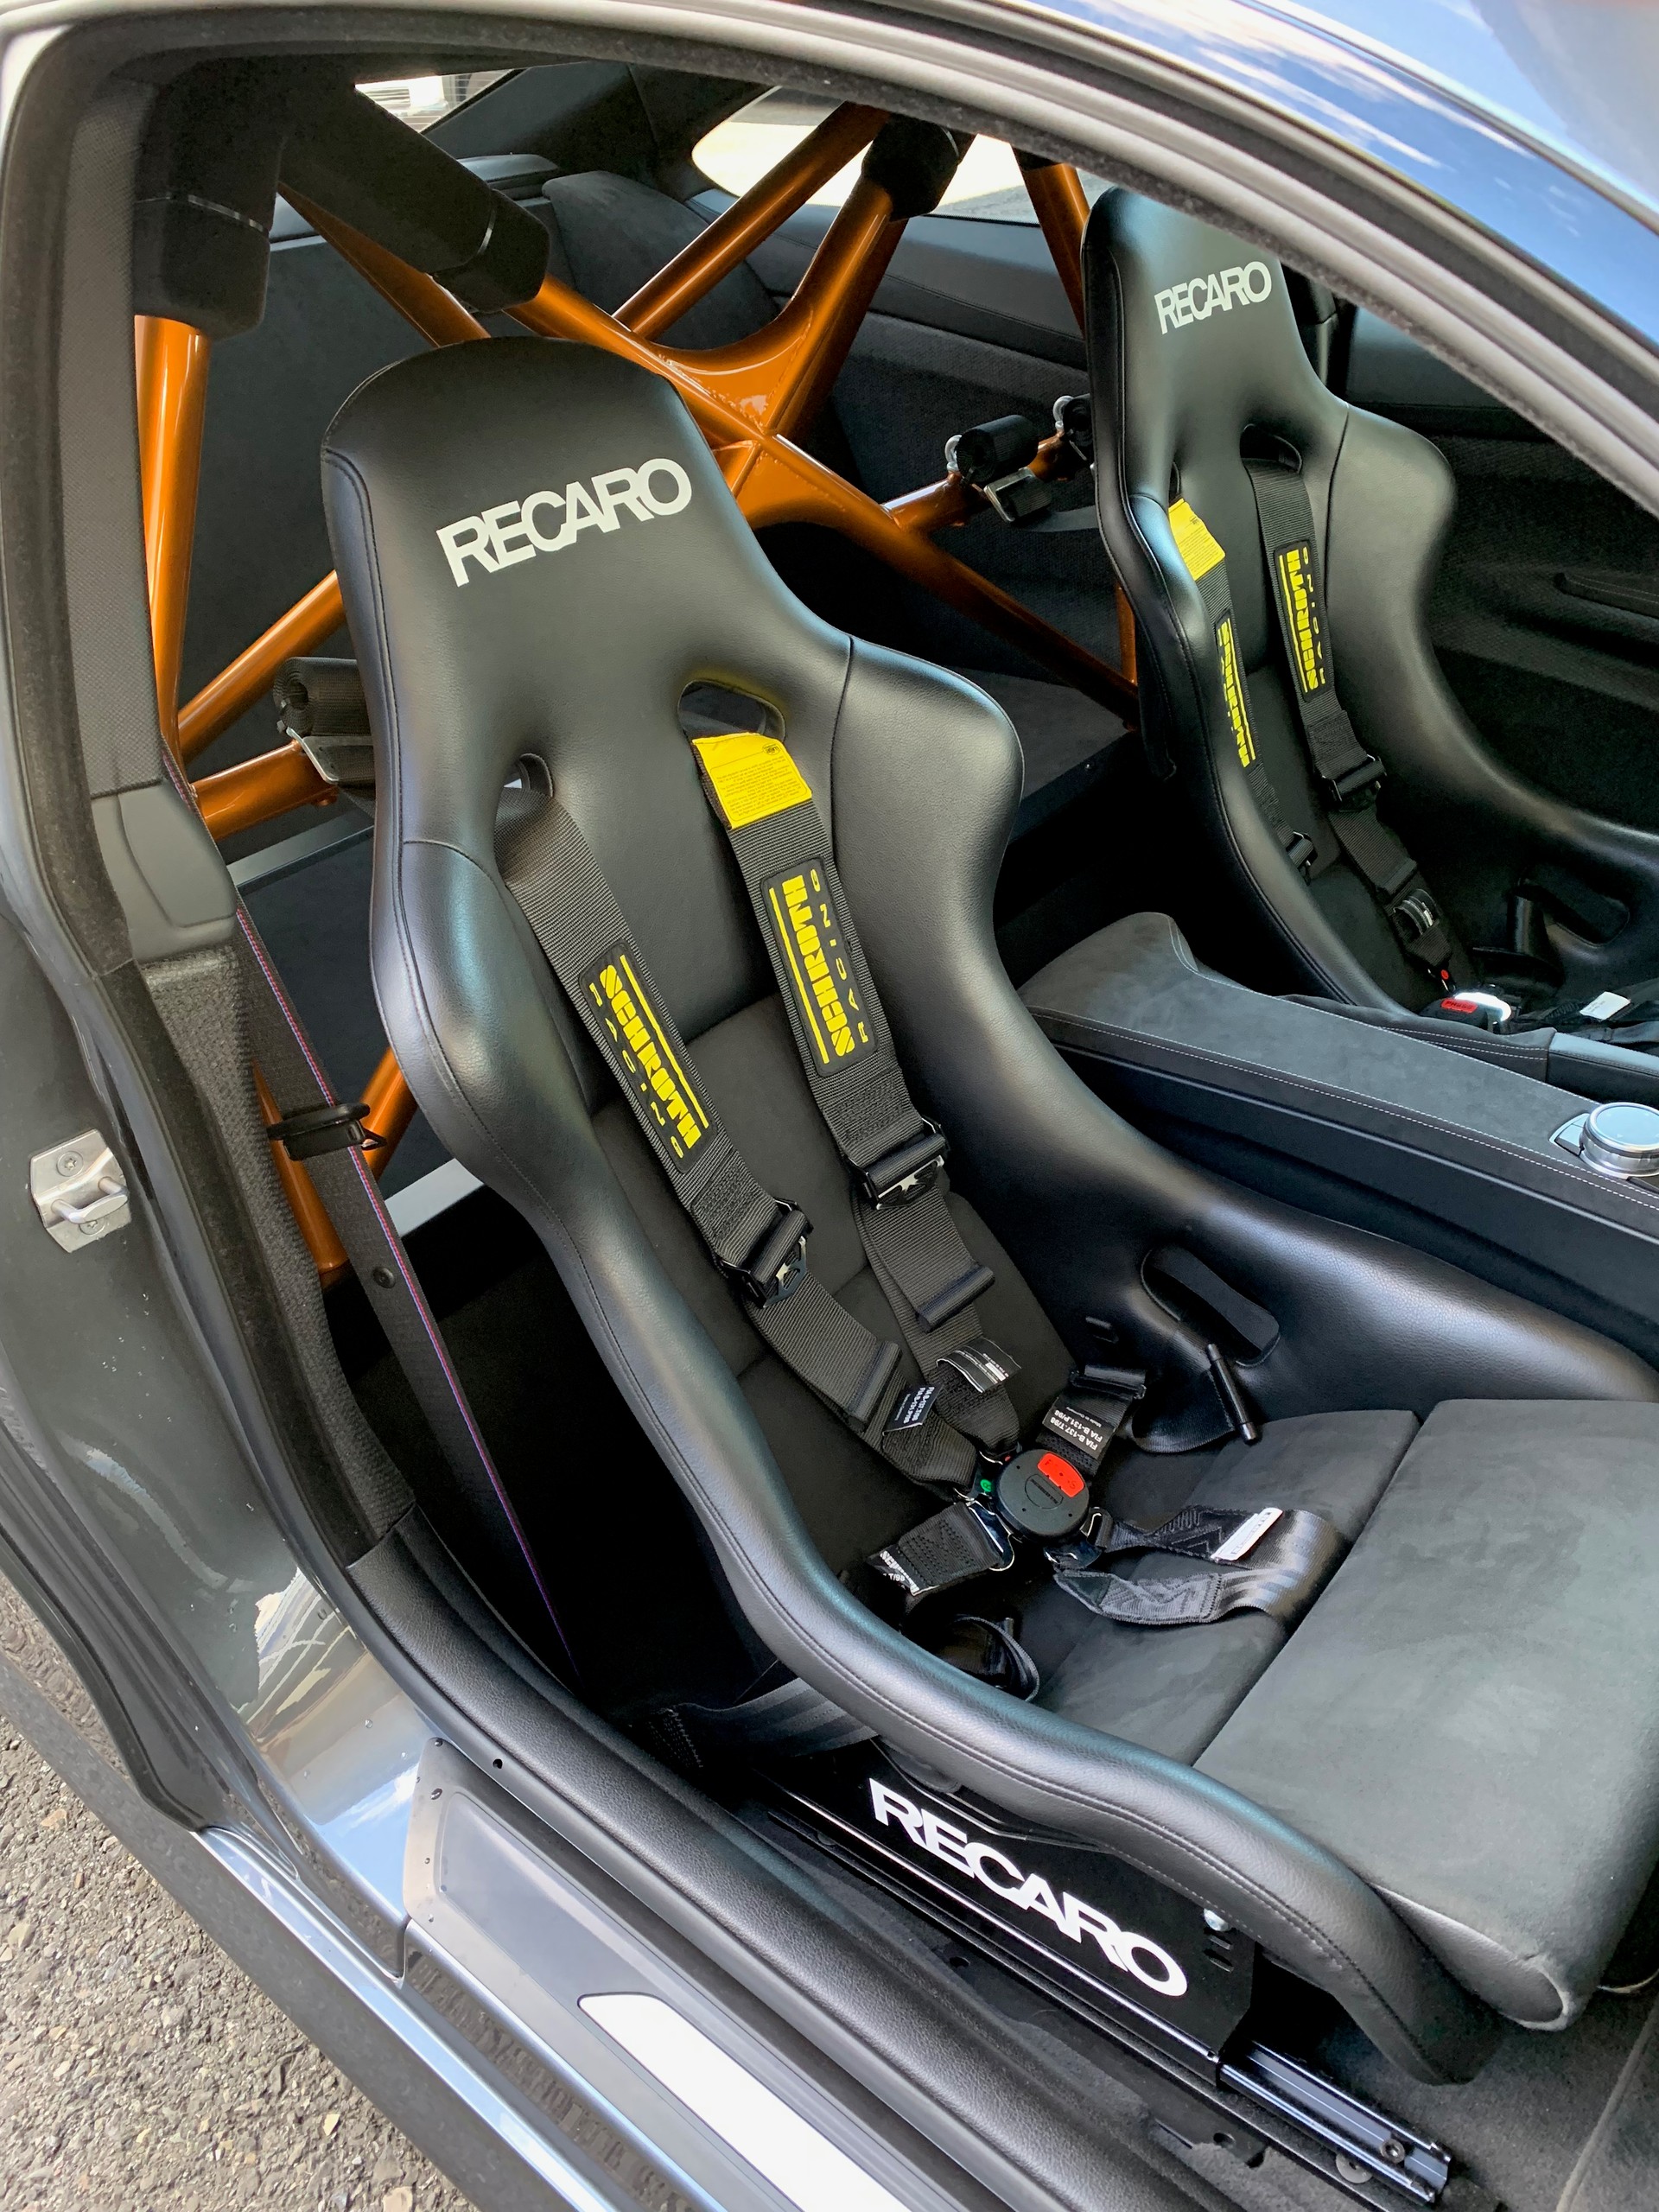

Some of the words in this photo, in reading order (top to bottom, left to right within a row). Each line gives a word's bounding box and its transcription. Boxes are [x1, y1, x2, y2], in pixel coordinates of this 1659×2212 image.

[1154, 261, 1272, 335] RECARO
[436, 458, 692, 588] RECARO
[1287, 549, 1319, 690] SCHROTH
[1302, 546, 1325, 685] RACING
[782, 874, 855, 1057] SCHROTH
[810, 868, 868, 1043] RACING
[589, 982, 683, 1159] RACING
[599, 964, 702, 1149] SCHROTH
[1085, 1438, 1098, 1451] FIA
[1090, 1430, 1103, 1443] FIA
[869, 1777, 1187, 1997] RECARO
